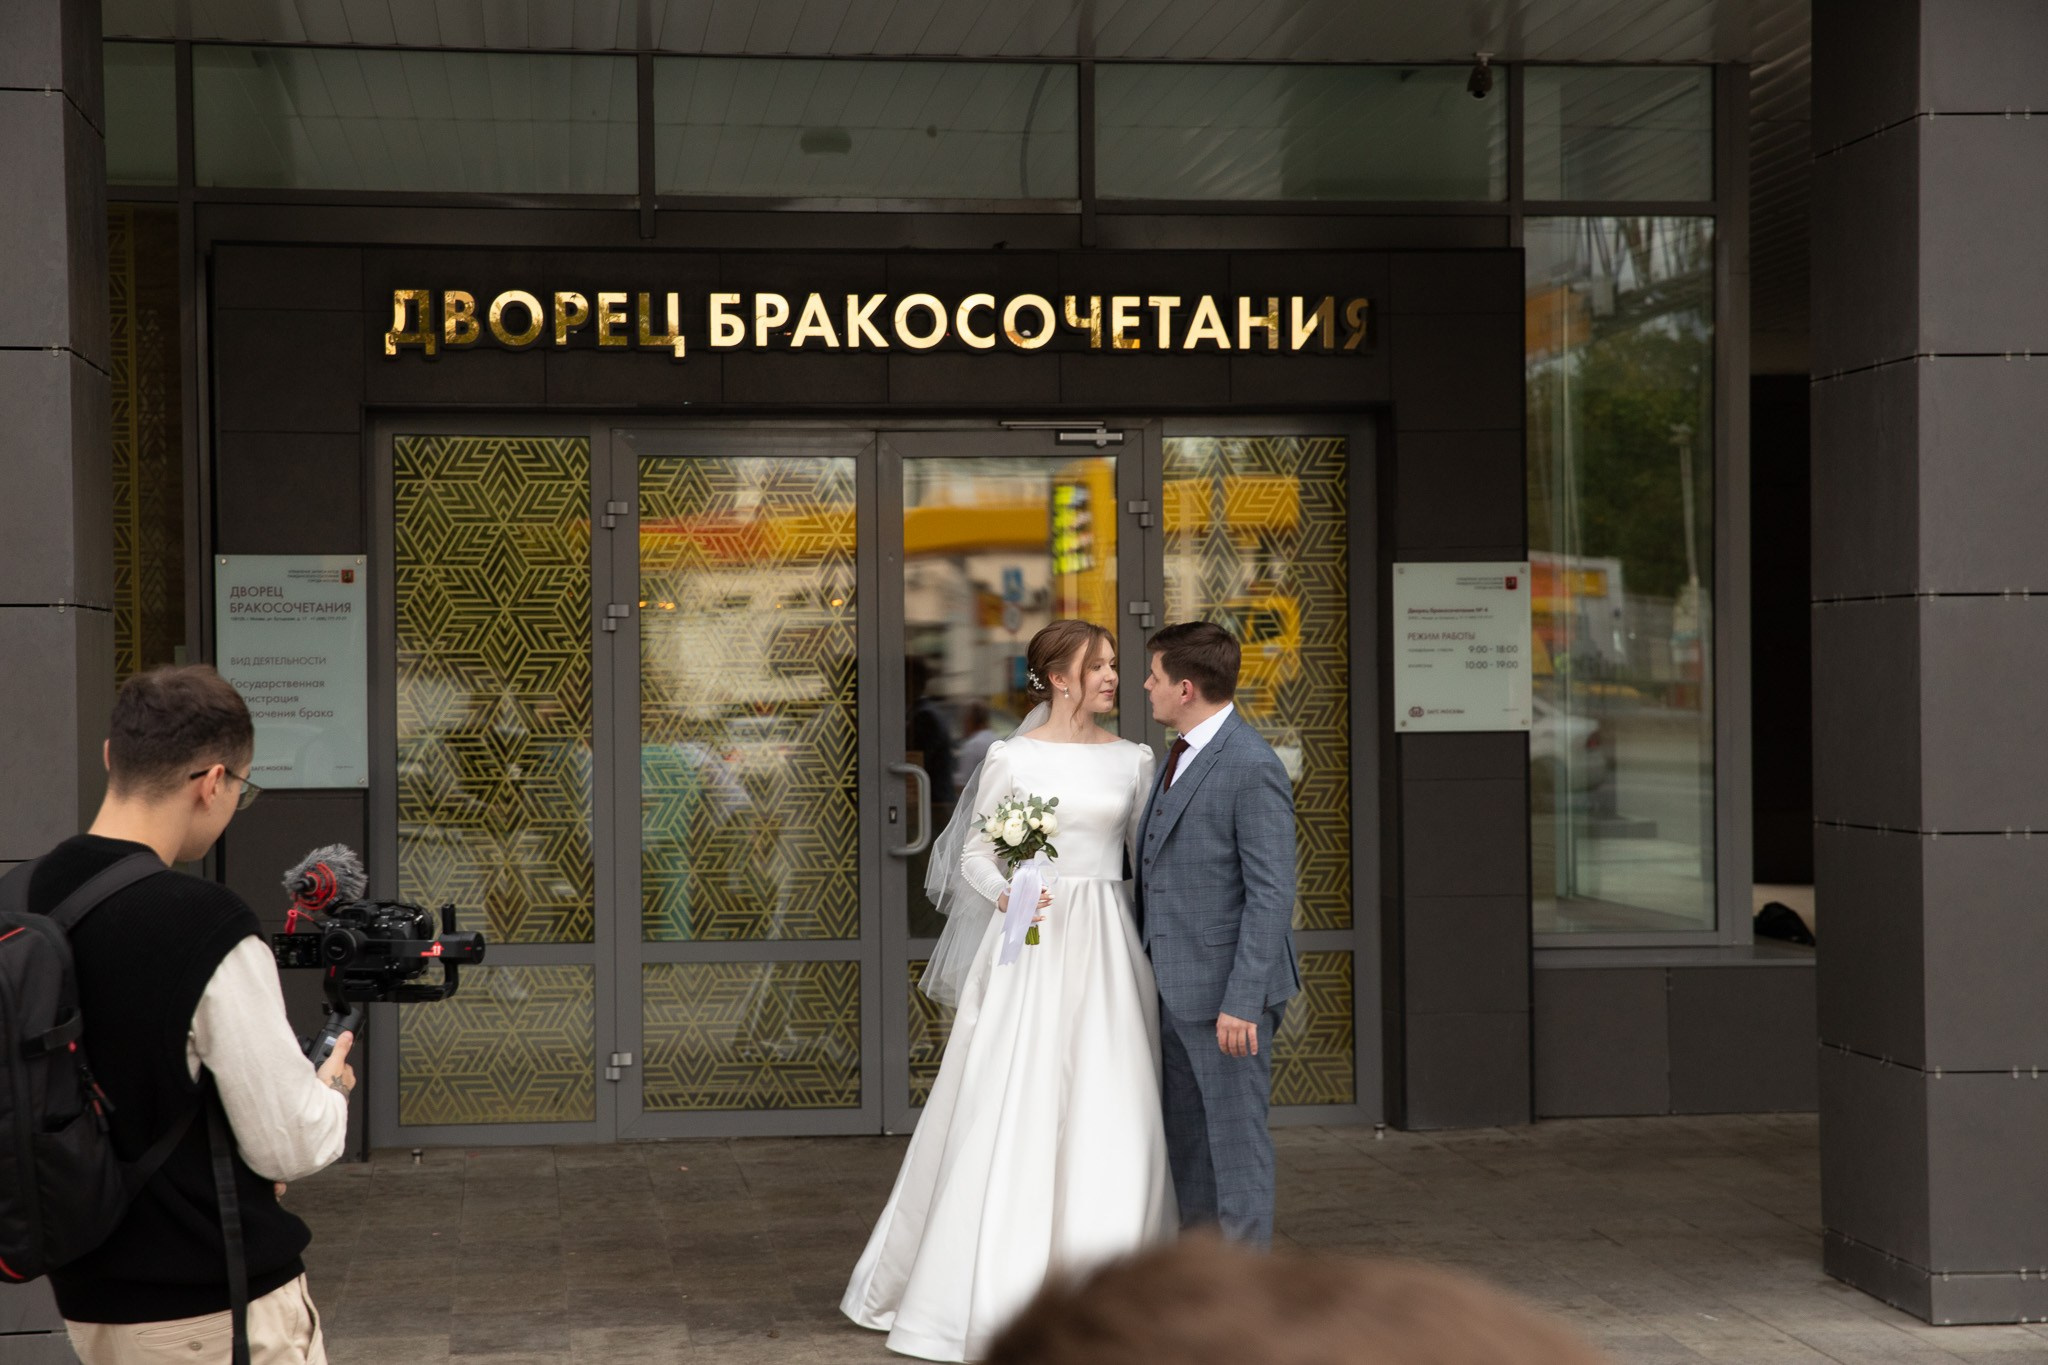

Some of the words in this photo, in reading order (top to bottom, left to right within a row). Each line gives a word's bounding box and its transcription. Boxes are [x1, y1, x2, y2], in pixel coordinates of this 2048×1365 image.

[384, 289, 686, 357] ДВОРЕЦ
[709, 292, 1372, 350] БРАКОСОЧЕТАНИЯ
[230, 586, 284, 599] ДВОРЕЦ
[229, 602, 352, 613] БРАКОСОЧЕТАНИЯ
[1407, 632, 1440, 641] РЕЖИМ
[1441, 631, 1476, 640] РАБОТЫ
[1468, 645, 1488, 654] 9:00
[1496, 644, 1518, 653] 18:00
[230, 656, 251, 666] ВИД
[252, 656, 327, 666] ДЕЯТЕЛЬНОСТИ
[1465, 660, 1488, 669] 10:00
[1496, 660, 1518, 669] 19:00
[231, 678, 325, 691] Государственная
[243, 695, 299, 705] гистрация
[251, 710, 296, 718] лючения
[299, 707, 334, 719] брака
